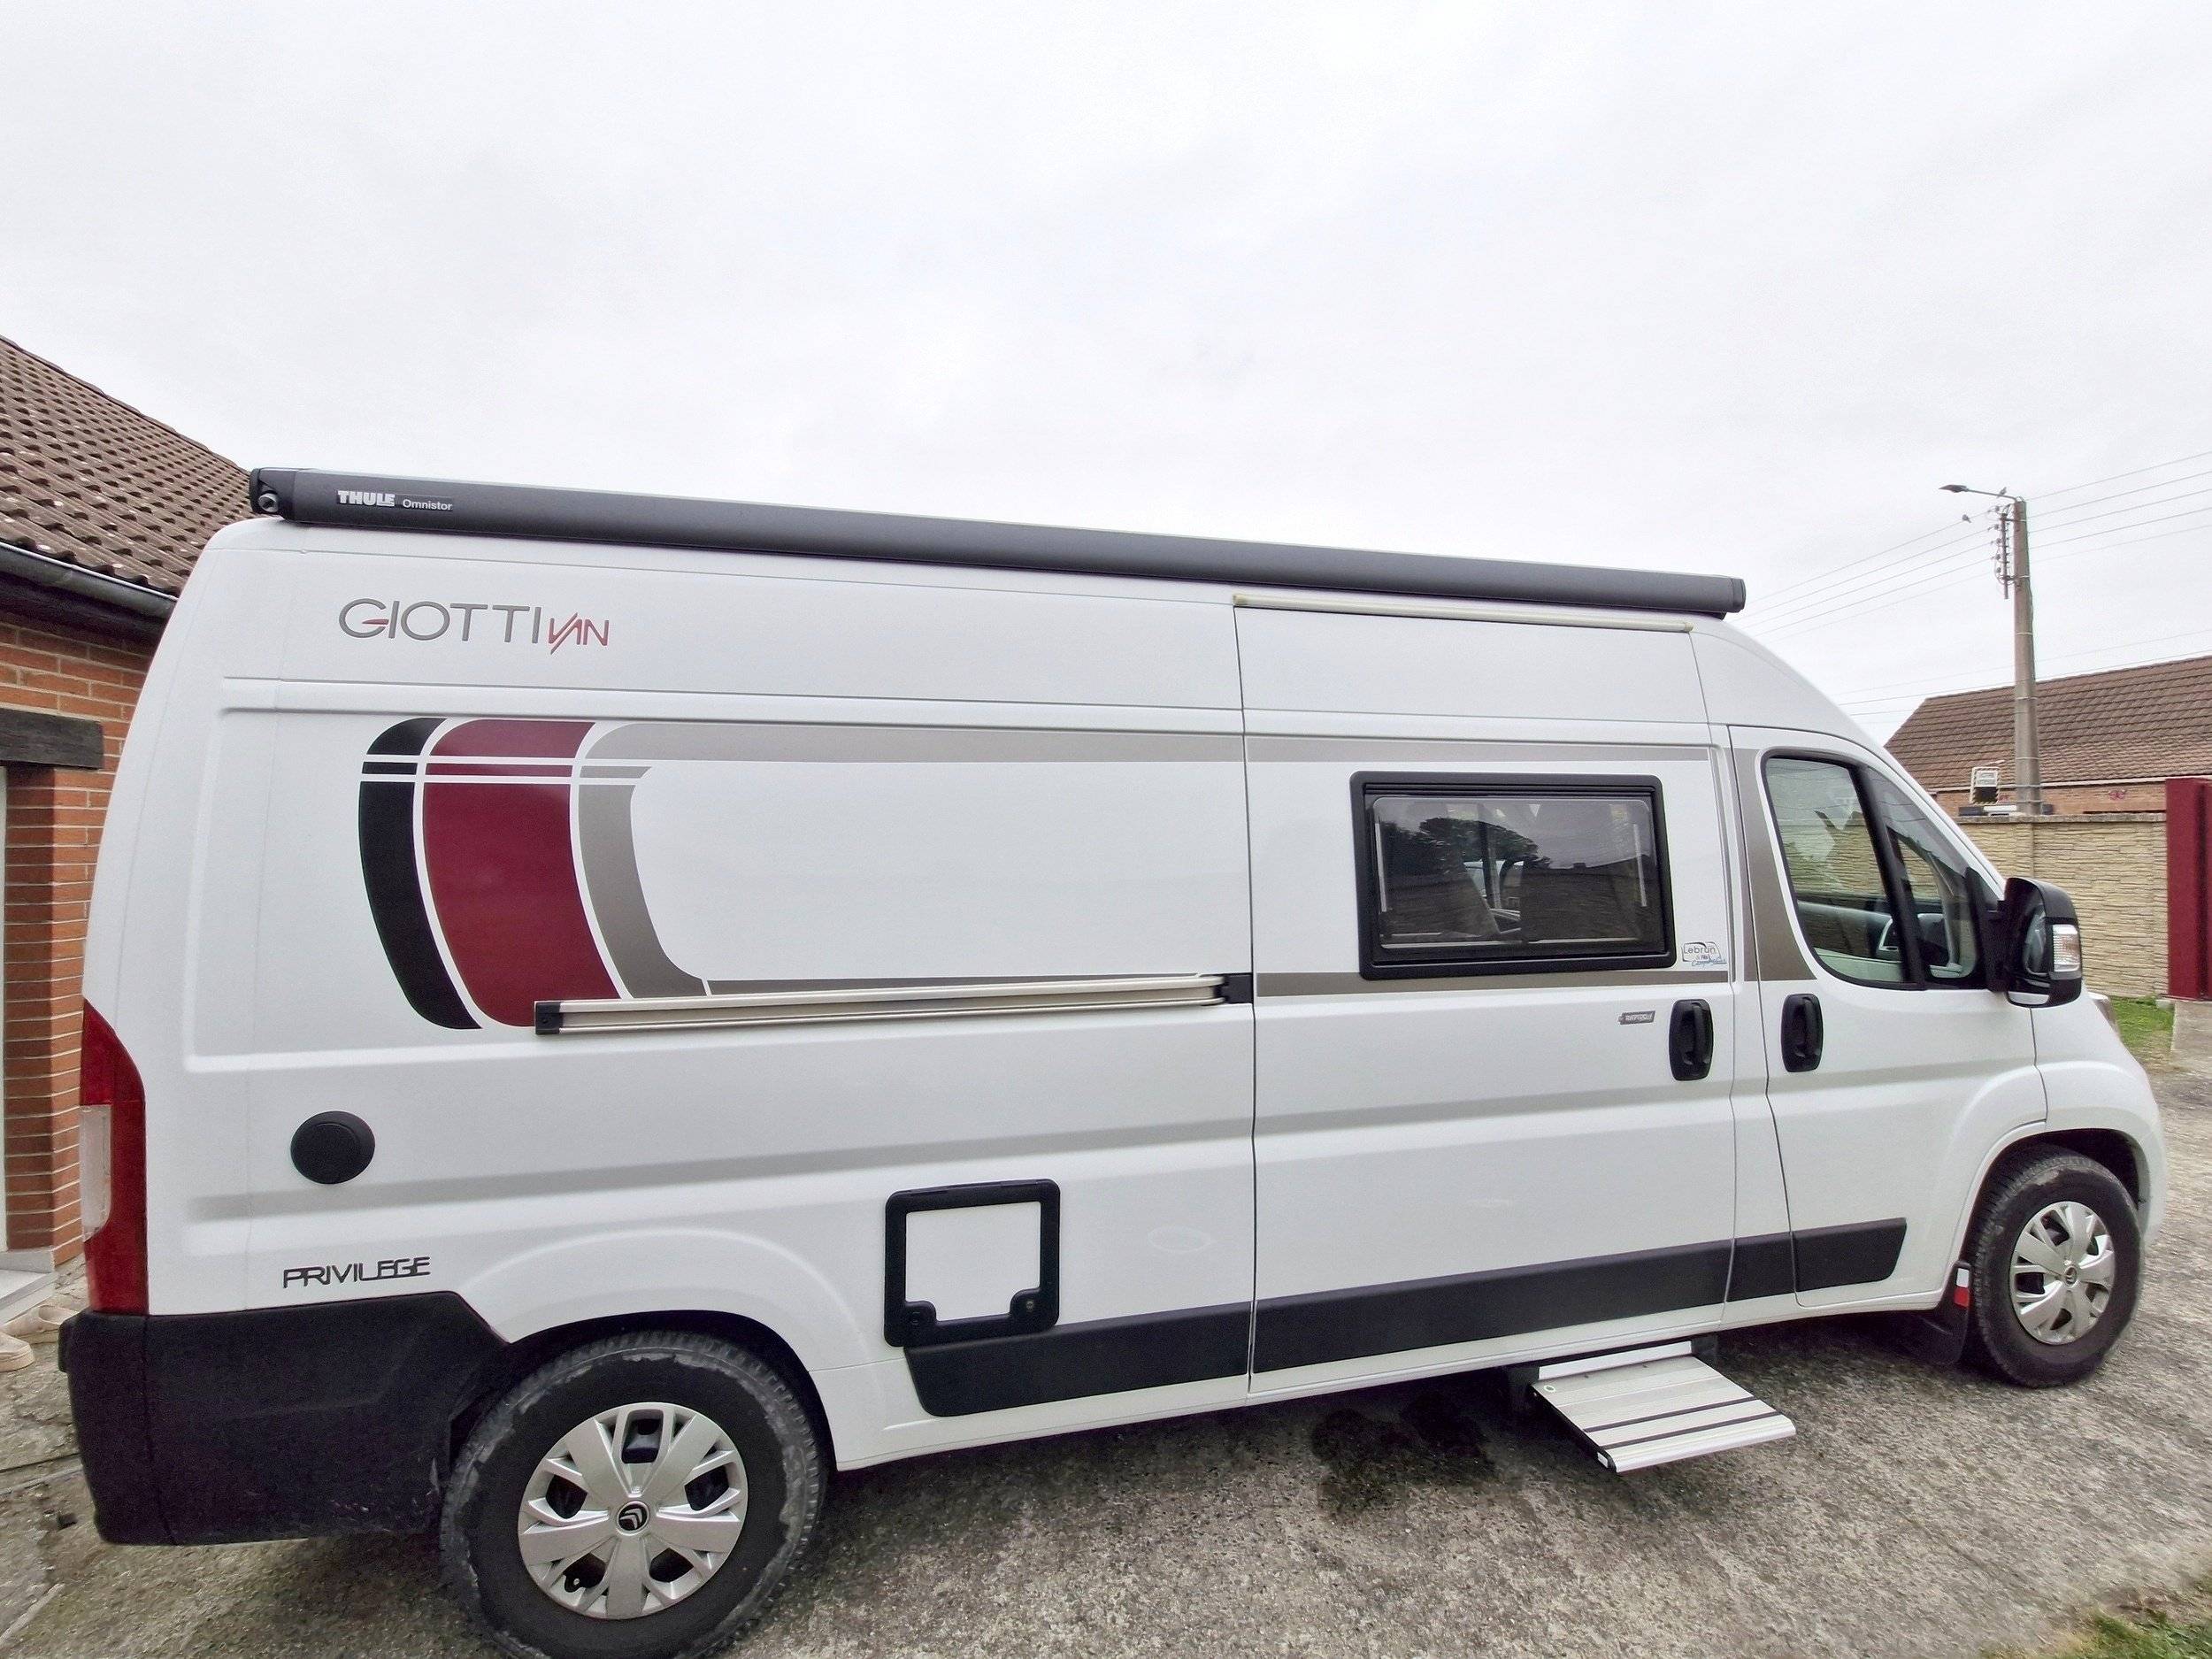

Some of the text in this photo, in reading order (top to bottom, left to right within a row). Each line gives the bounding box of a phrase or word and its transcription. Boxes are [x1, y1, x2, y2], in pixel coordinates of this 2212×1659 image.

[337, 490, 453, 511] THULE Omnistor
[1684, 946, 1716, 955] Lebrun
[283, 1256, 431, 1288] PRIVILEGE
